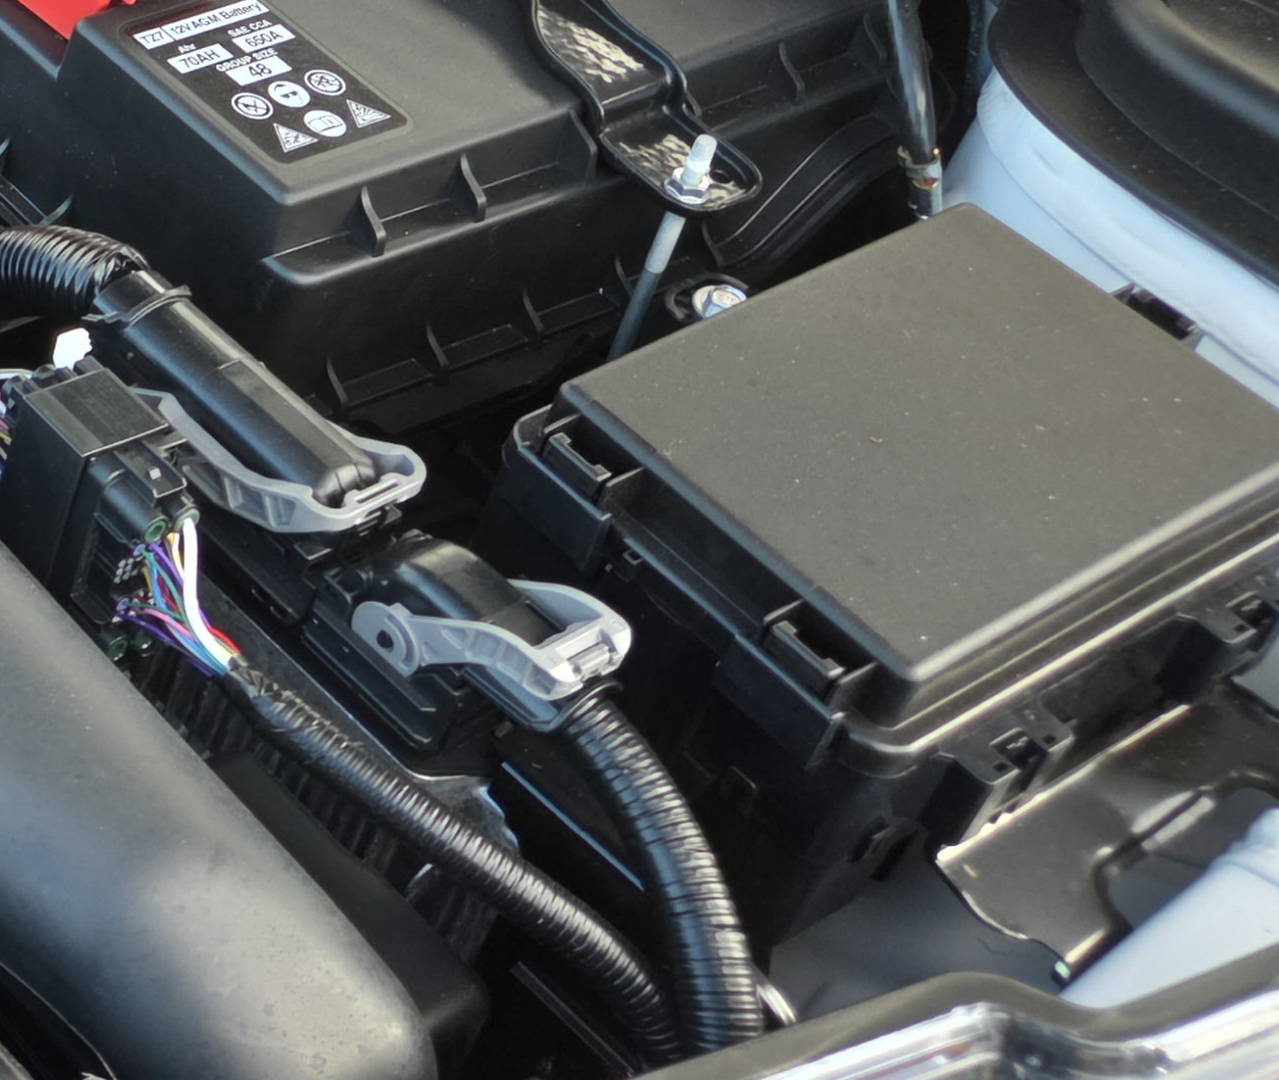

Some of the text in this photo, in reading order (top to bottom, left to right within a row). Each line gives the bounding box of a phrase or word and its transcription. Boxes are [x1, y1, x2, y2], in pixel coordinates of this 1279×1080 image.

[139, 2, 261, 44] TZ7 12V AGM Battery
[227, 19, 273, 37] SAE CCA
[245, 30, 284, 48] 650A
[179, 49, 221, 69] 70AH
[216, 47, 278, 72] GROUP SIZE
[247, 63, 272, 78] 48
